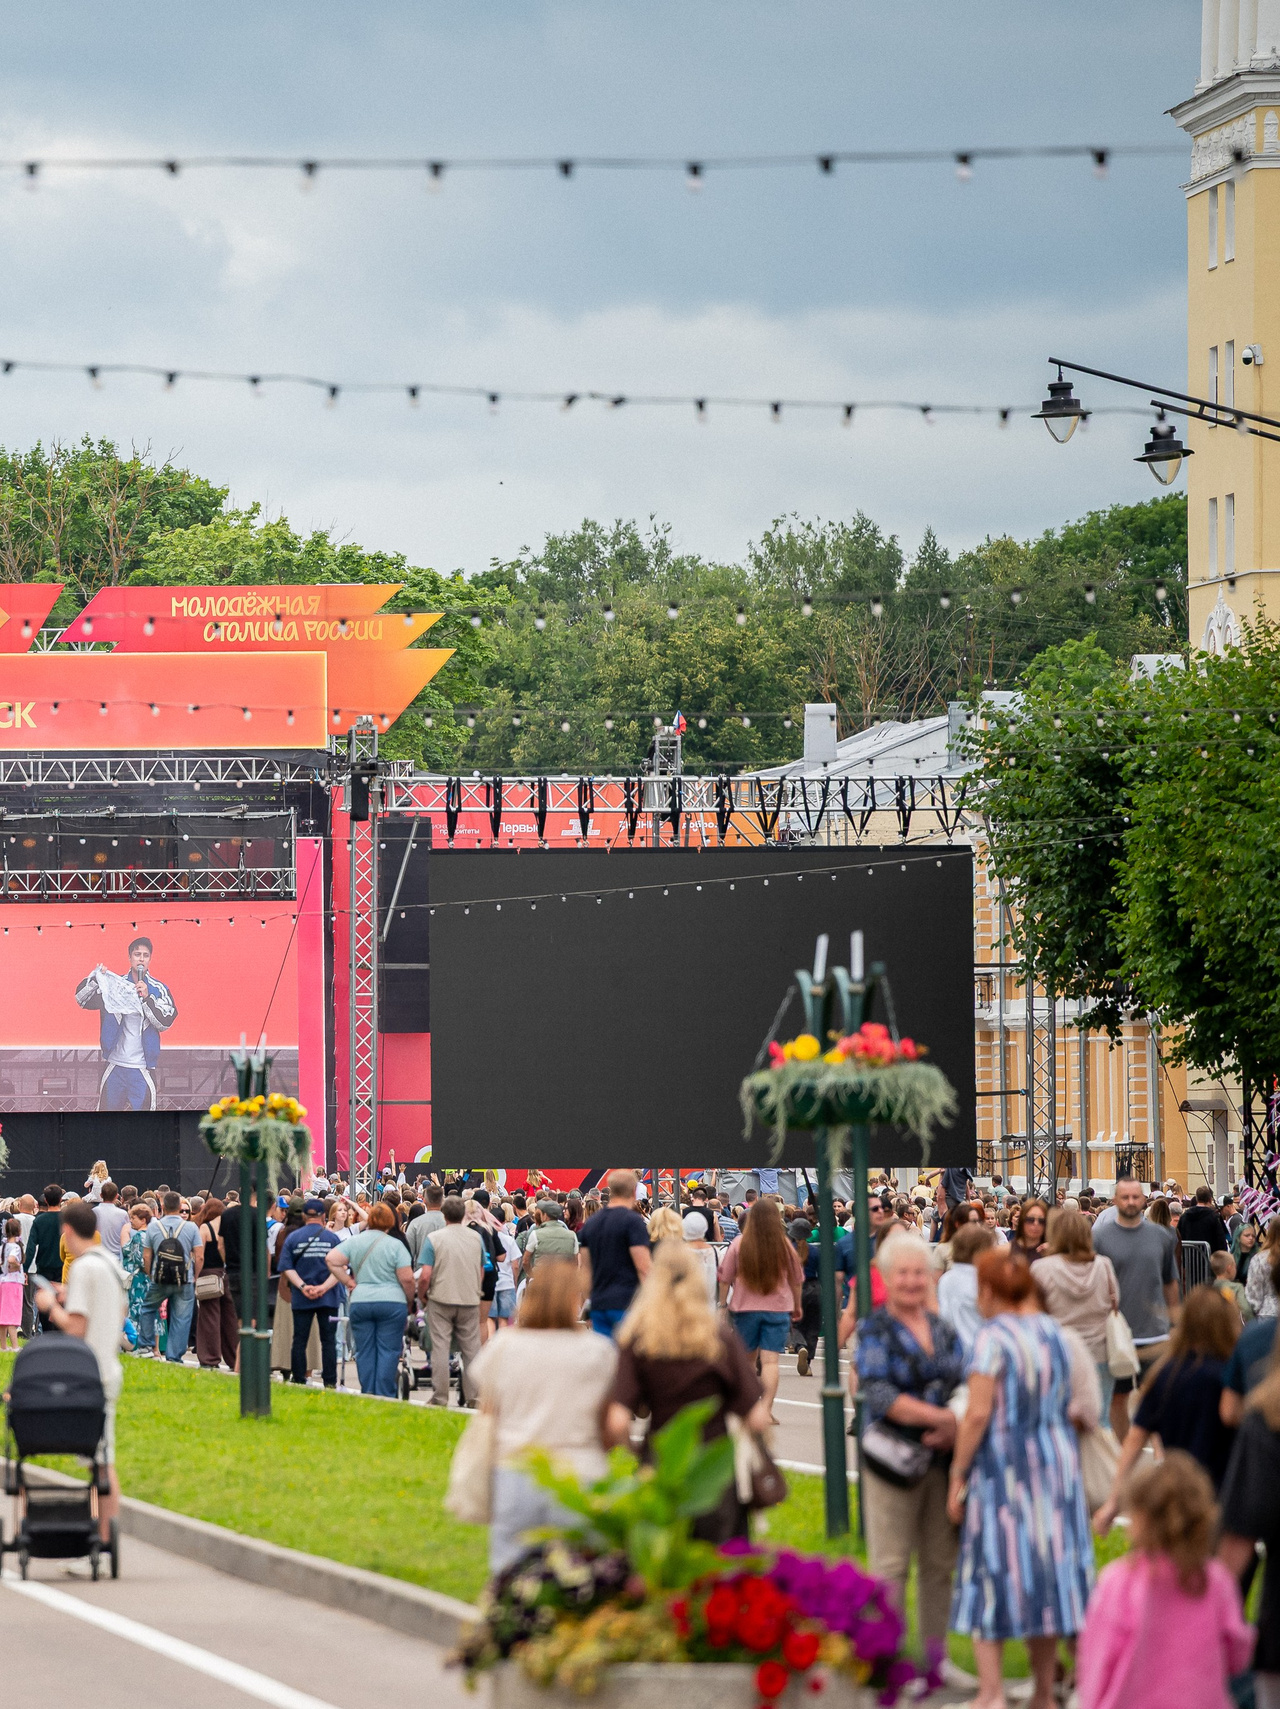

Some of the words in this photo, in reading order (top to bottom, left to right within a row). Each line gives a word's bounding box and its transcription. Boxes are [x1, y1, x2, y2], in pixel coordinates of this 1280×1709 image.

[171, 592, 321, 617] МОЛОДЁЖНАЯ
[203, 621, 299, 642] СТОЛИЦА
[304, 620, 383, 641] РОССИИ
[439, 828, 480, 836] прритеты
